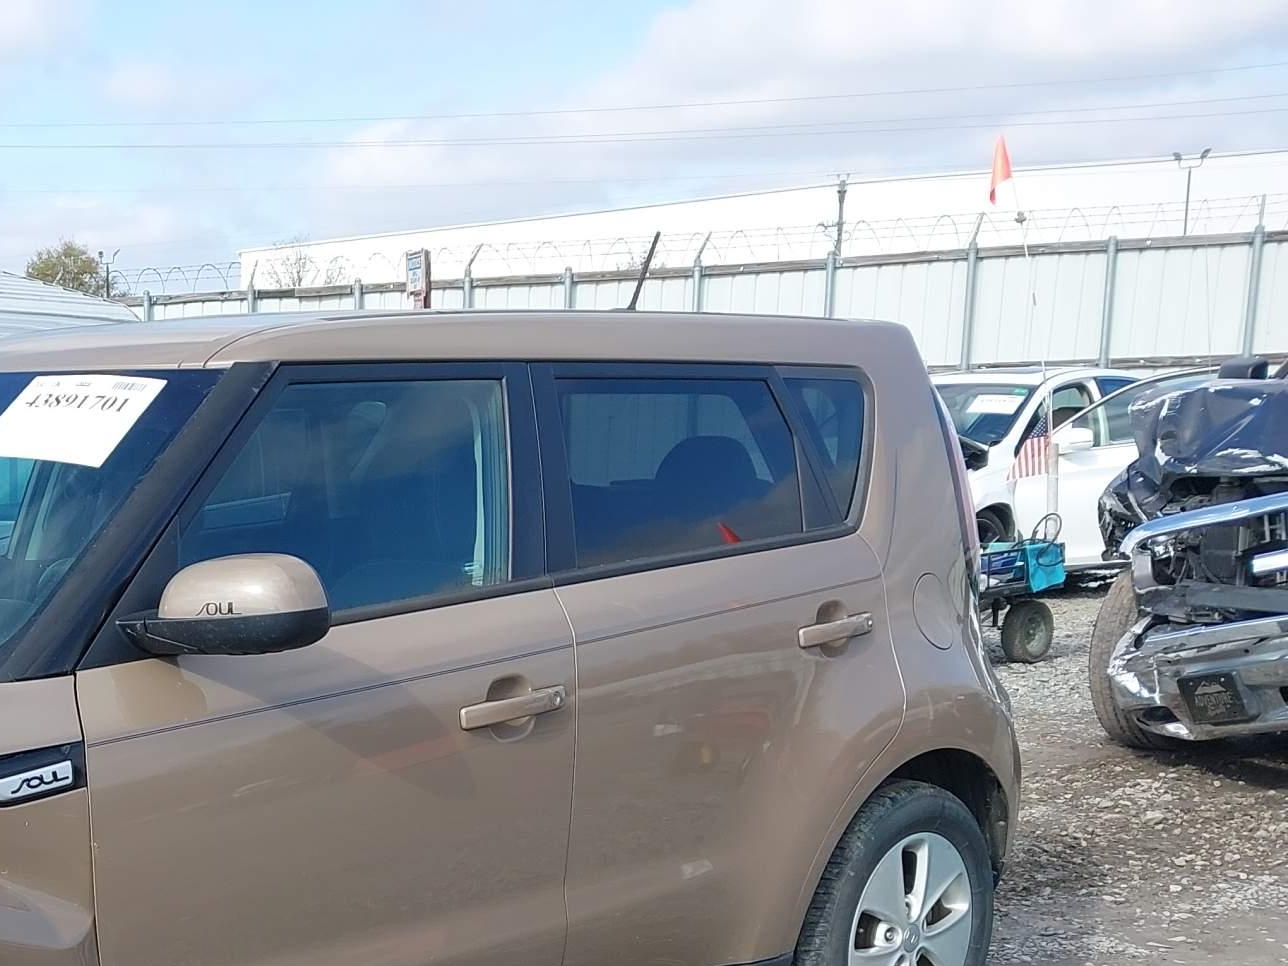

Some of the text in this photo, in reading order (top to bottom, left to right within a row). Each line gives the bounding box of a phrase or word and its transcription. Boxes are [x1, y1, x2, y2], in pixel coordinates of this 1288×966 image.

[25, 393, 130, 412] 43891701
[195, 601, 242, 617] SOUL
[10, 770, 70, 794] SOUL
